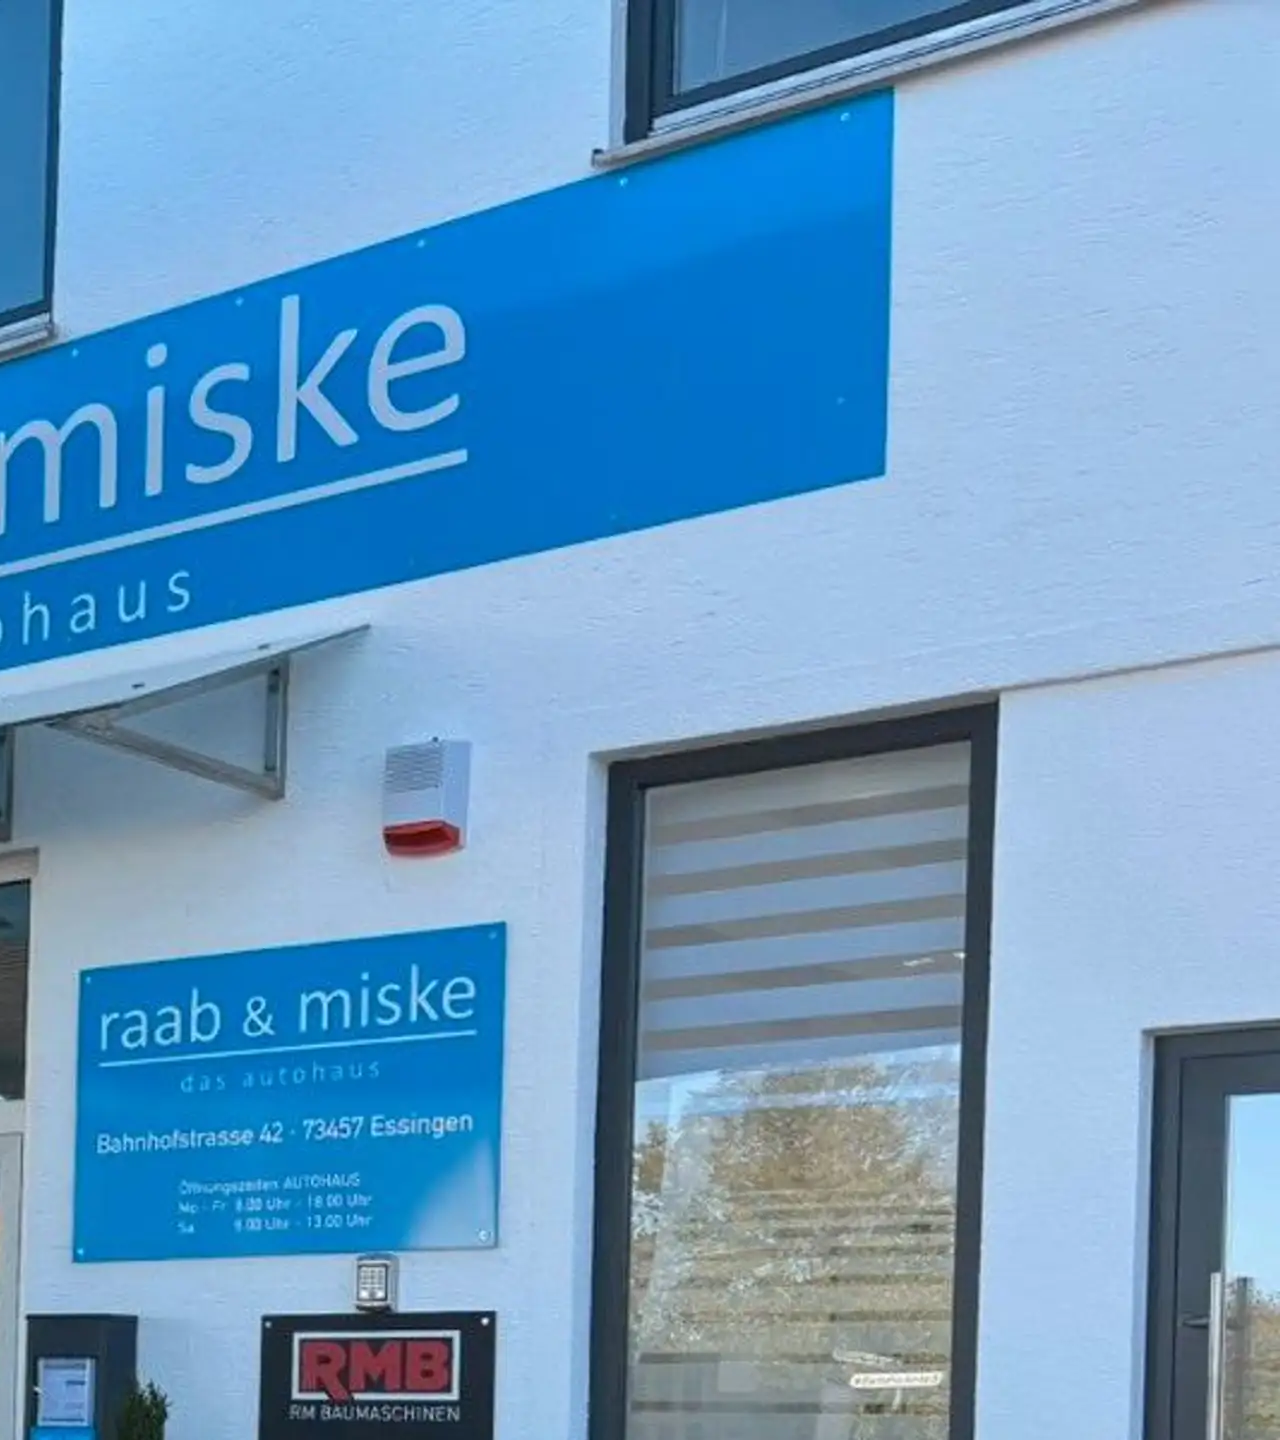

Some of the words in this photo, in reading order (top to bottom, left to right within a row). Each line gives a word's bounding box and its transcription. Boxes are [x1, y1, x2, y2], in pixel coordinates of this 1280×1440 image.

[99, 987, 221, 1051] raab
[242, 996, 276, 1037] &
[299, 963, 477, 1033] miske
[180, 1073, 226, 1094] das
[242, 1061, 381, 1089] autohaus
[96, 1126, 254, 1155] Bahnhofstrasse
[259, 1122, 284, 1143] 42
[302, 1117, 364, 1141] 73457
[370, 1112, 474, 1138] Essingen
[283, 1172, 361, 1191] AUTOHAUS
[301, 1341, 452, 1401] RMB
[288, 1404, 316, 1421] RM
[320, 1403, 461, 1423] BAUMASCHINEN
